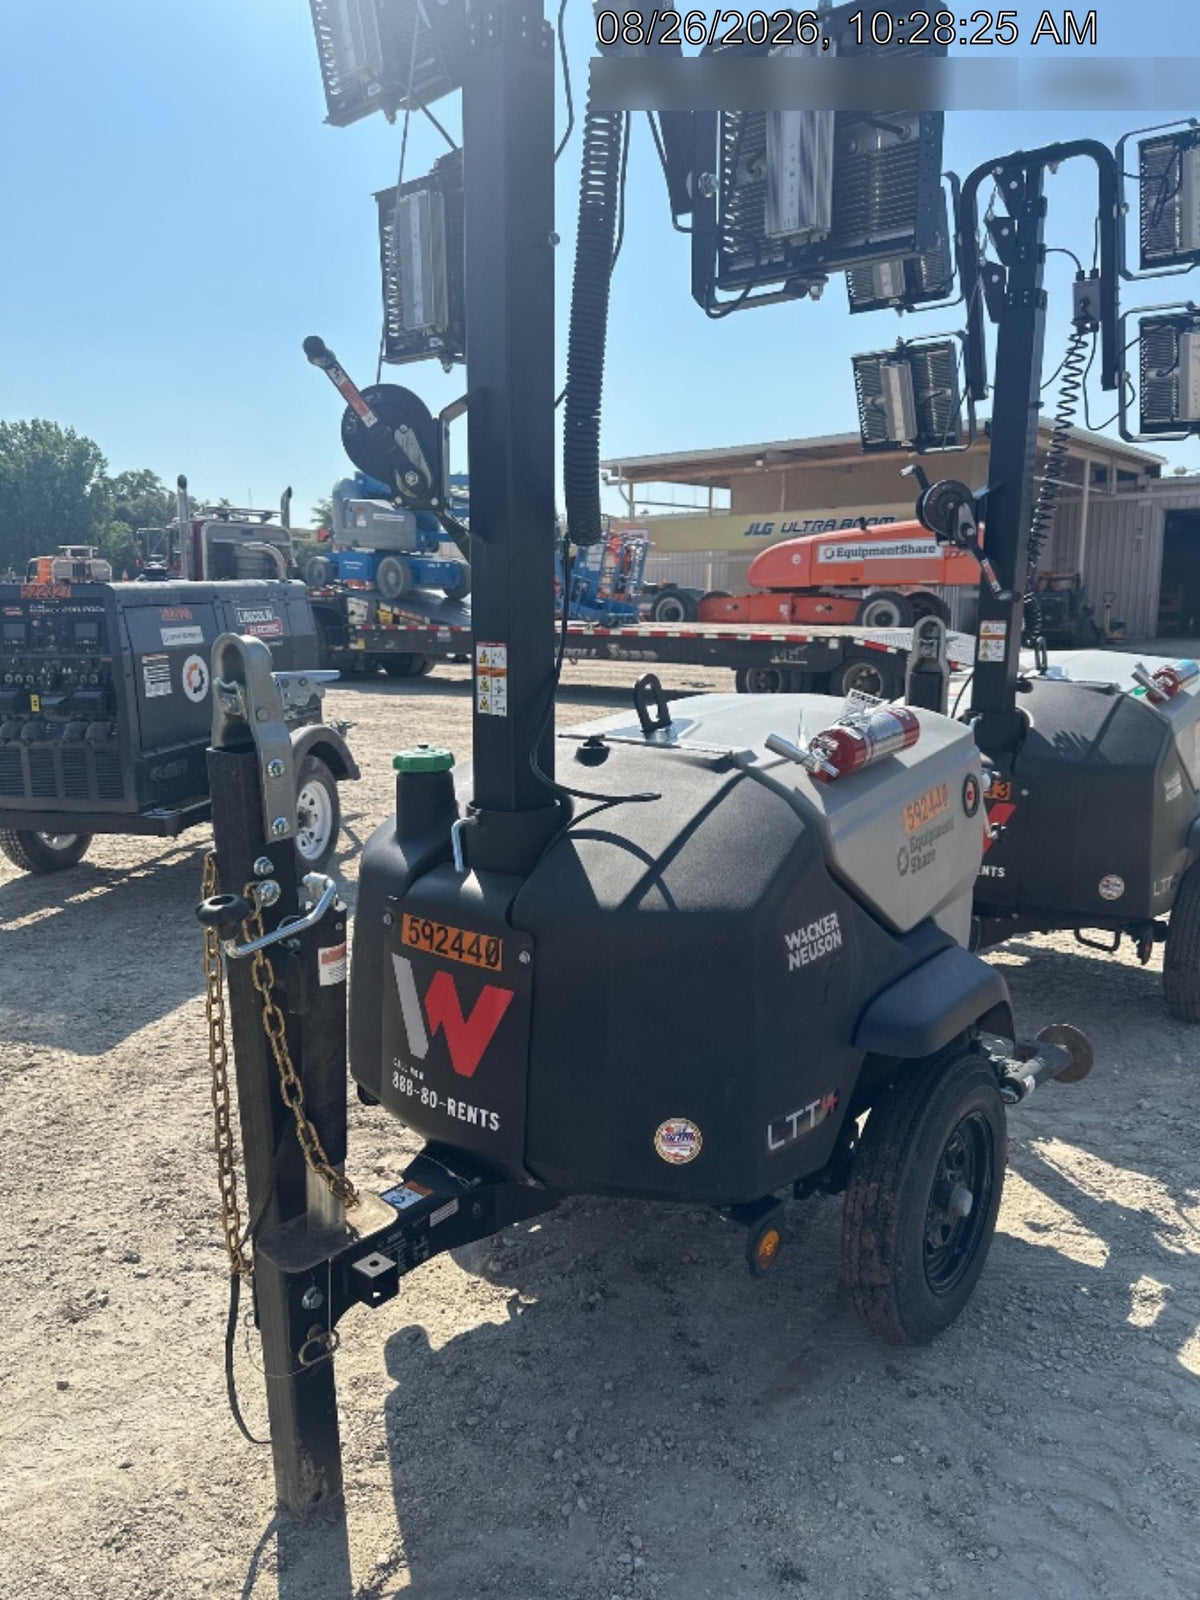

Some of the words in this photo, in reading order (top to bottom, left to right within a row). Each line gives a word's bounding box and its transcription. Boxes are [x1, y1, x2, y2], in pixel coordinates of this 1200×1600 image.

[745, 522, 775, 536] JLG
[781, 518, 836, 534] ULTRA
[836, 544, 936, 559] EquipmentShare
[909, 816, 955, 854] Equipment
[909, 848, 936, 875] Share
[408, 916, 501, 968] 592440
[784, 911, 841, 951] WACKER
[787, 929, 843, 972] NEUSON
[391, 1070, 501, 1132] 888-80-RENTS
[767, 1092, 839, 1151] LTT4
